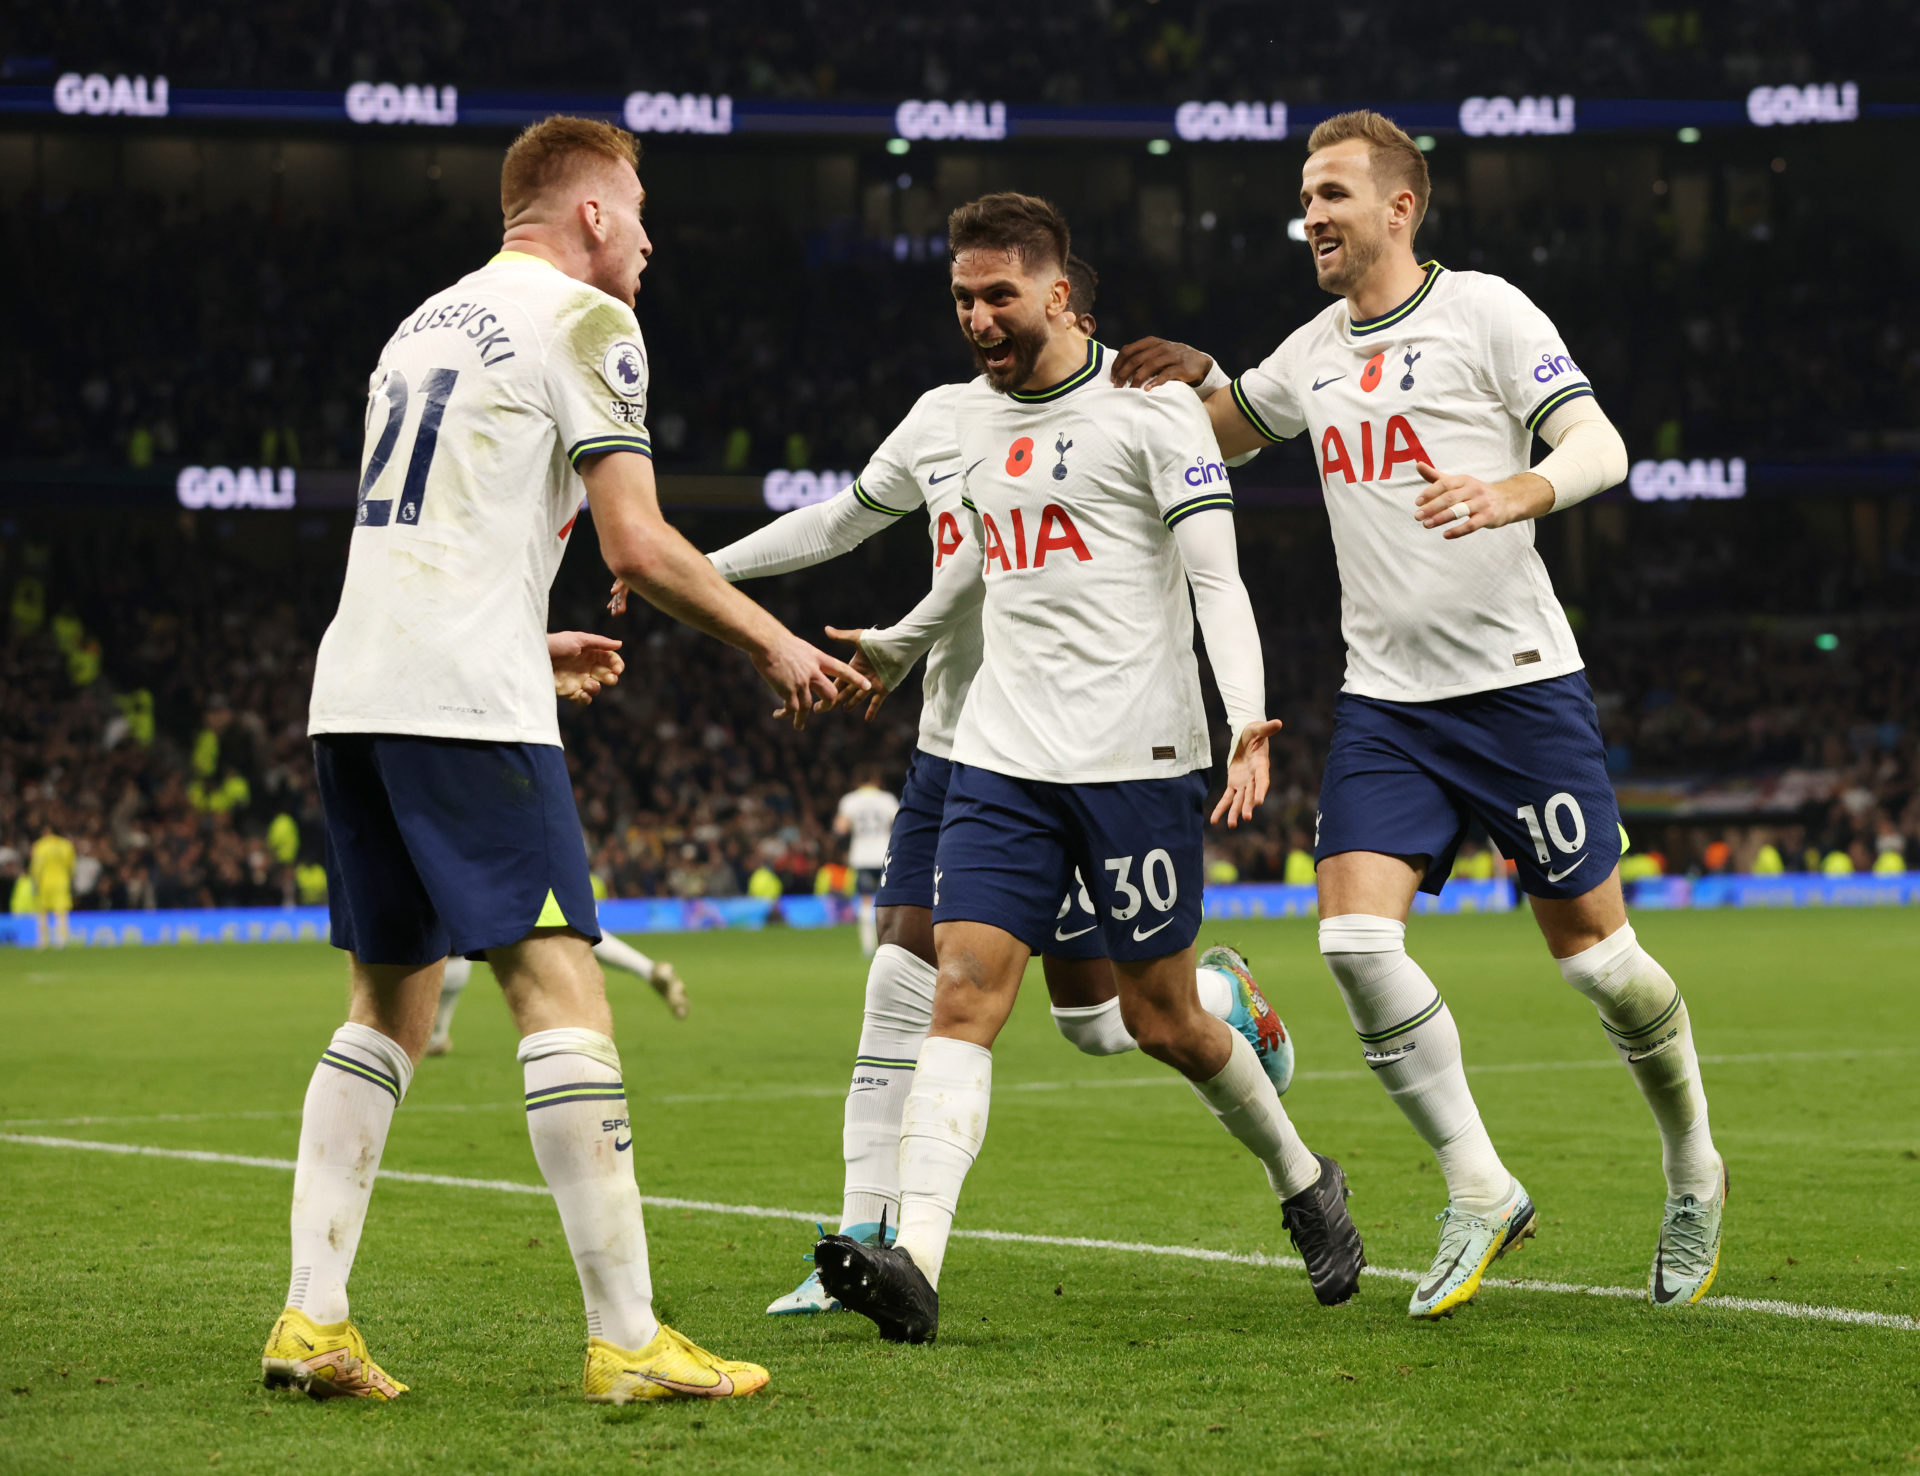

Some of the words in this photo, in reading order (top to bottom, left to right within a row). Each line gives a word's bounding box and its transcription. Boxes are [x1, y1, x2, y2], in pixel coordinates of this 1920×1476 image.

[55, 74, 168, 115] GOAL!
[346, 83, 457, 124] GOAL!
[624, 92, 732, 133] GOAL!
[1747, 83, 1857, 125] GOAL!
[895, 100, 1005, 140] GOAL!
[1176, 101, 1287, 141] GOAL!
[1459, 96, 1574, 136] GOAL!
[355, 368, 460, 527] 21
[1322, 414, 1436, 489] AIA
[177, 467, 295, 508] GOAL!
[1629, 458, 1745, 500] GOAL!
[984, 504, 1093, 575] AIA
[1517, 792, 1586, 864] 10
[1104, 848, 1178, 921] 30
[852, 1076, 889, 1086] URS
